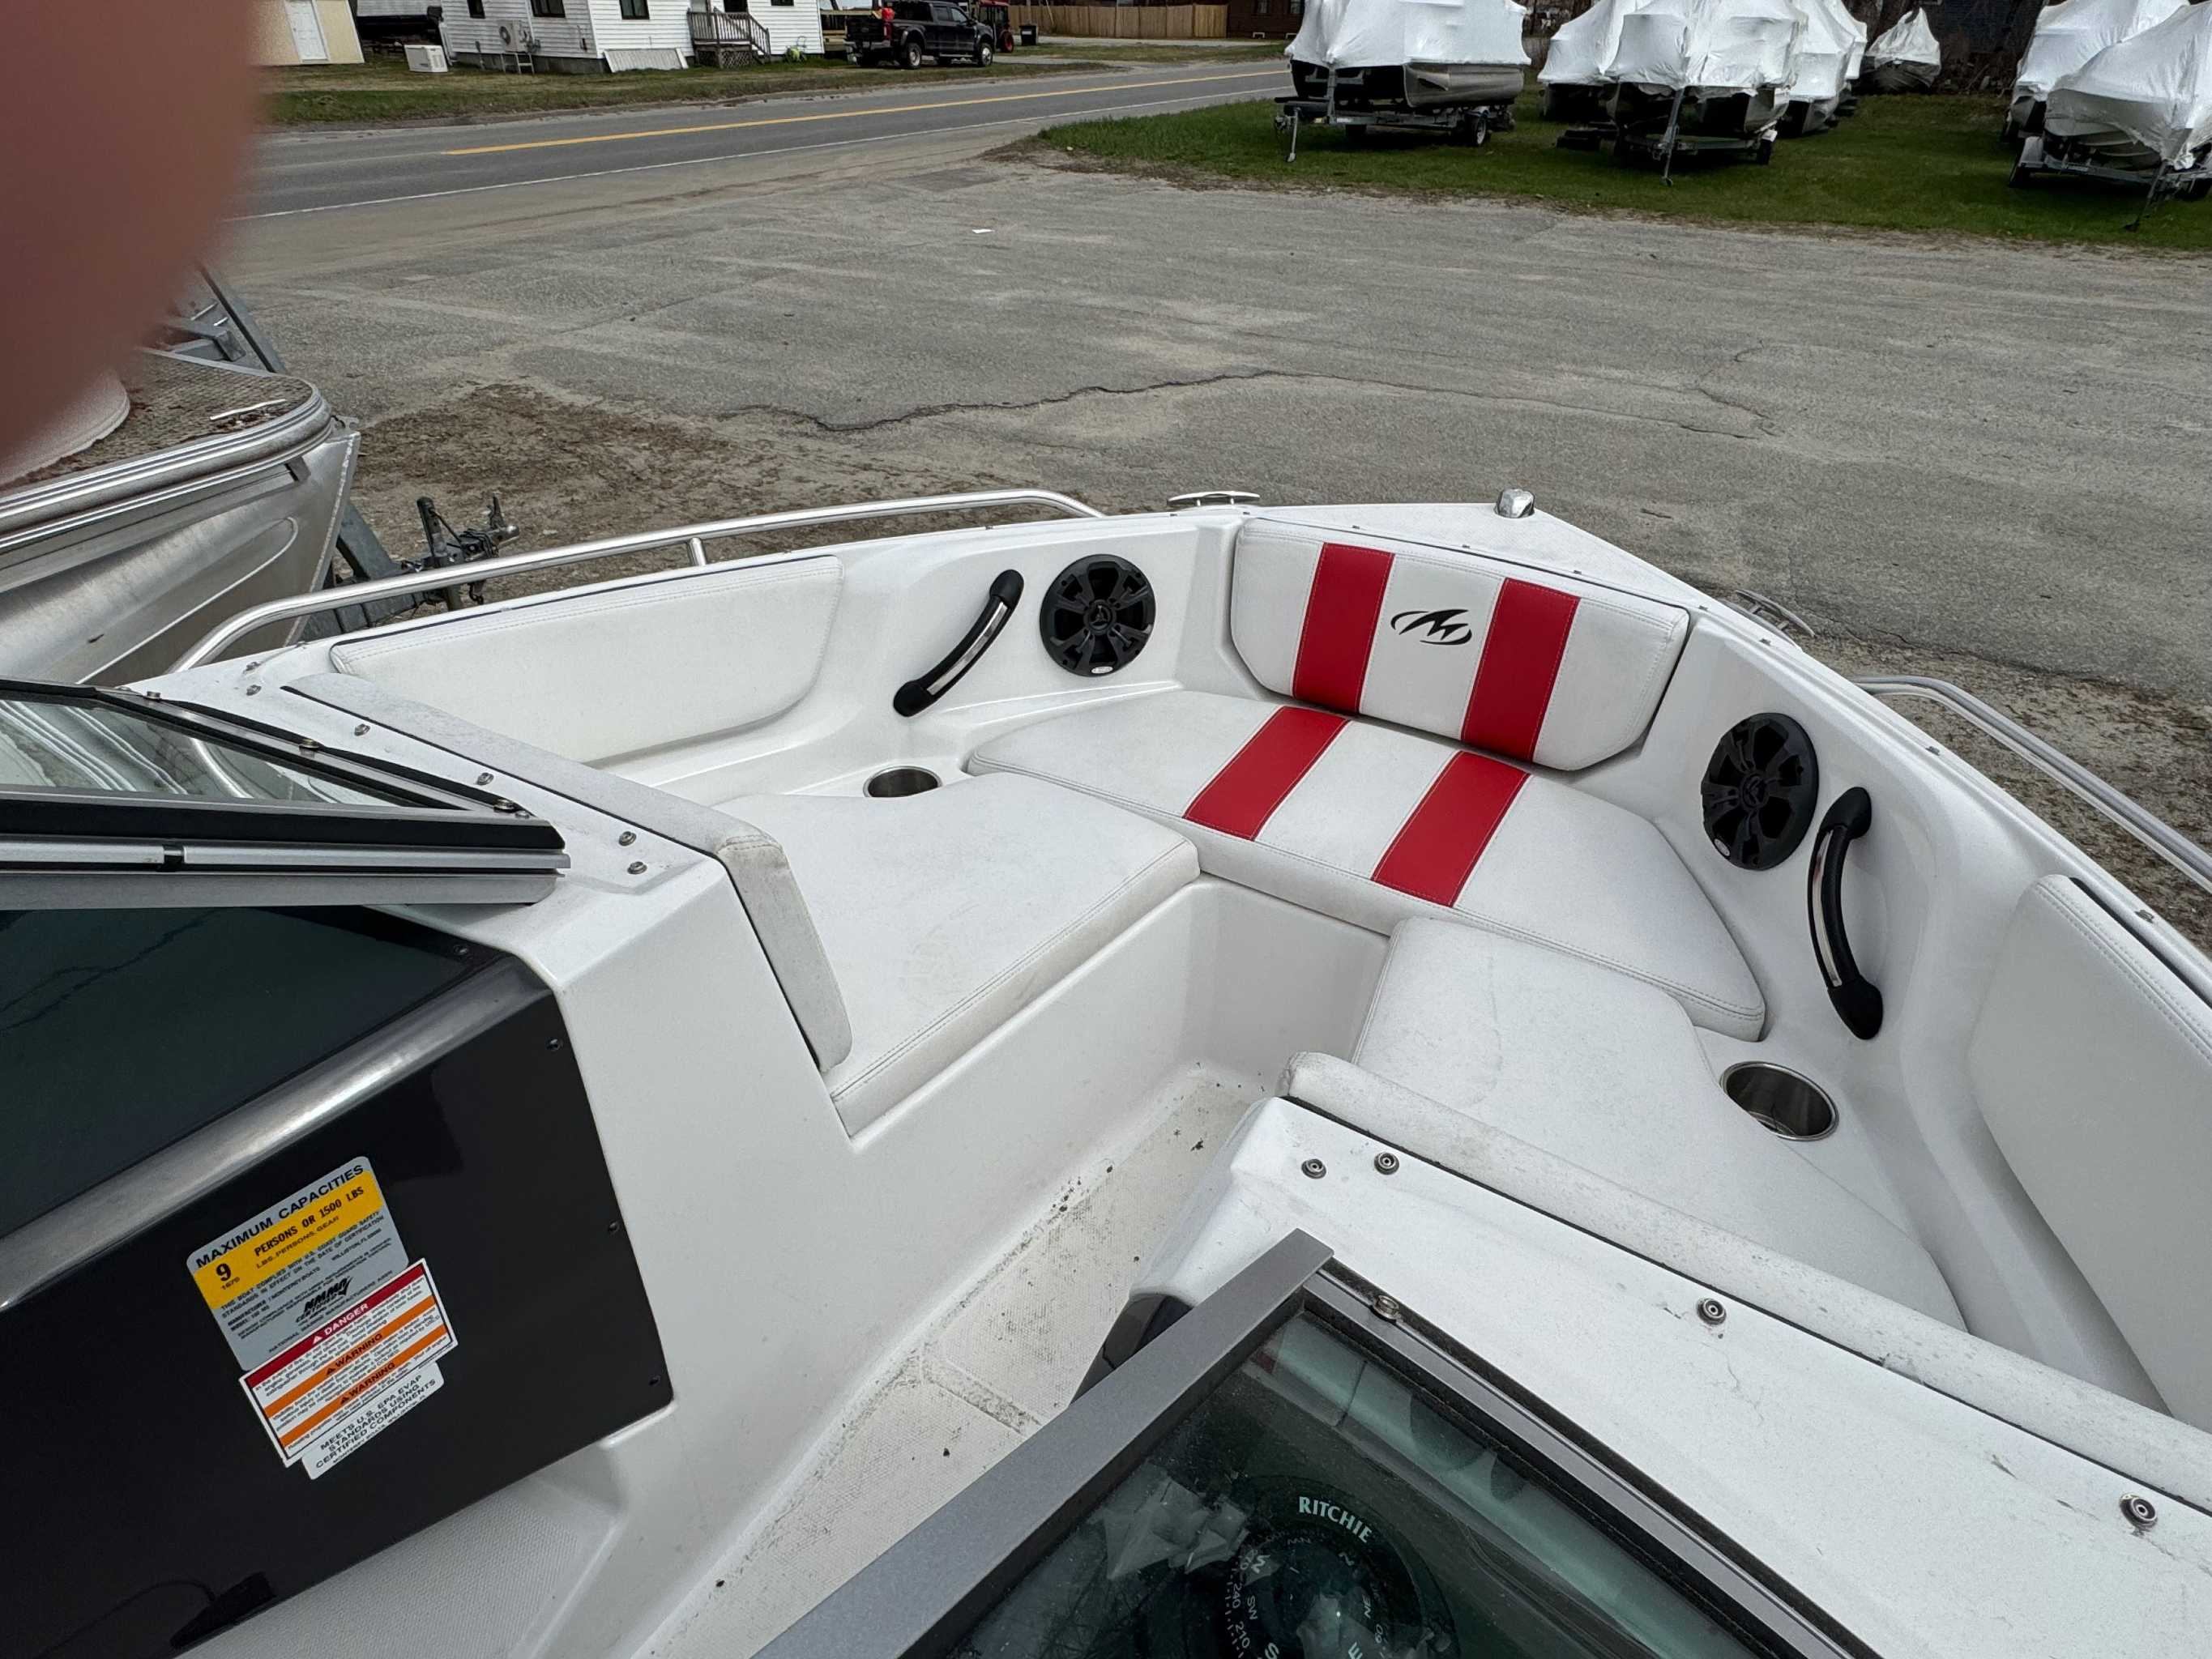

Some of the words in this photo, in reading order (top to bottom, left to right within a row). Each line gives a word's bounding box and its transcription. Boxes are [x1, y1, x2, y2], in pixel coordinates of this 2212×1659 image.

[194, 1217, 273, 1268] MAXIMUM
[277, 1163, 365, 1220] CAPACITIES
[216, 1263, 232, 1282] 9
[253, 1224, 298, 1256] PERSONS
[301, 1213, 316, 1228] OR
[318, 1198, 342, 1218] 1500
[345, 1185, 364, 1201] LBS
[316, 1215, 339, 1232] GEAR
[221, 1292, 258, 1318] STANDARDS
[268, 1271, 291, 1289] EFFECT
[304, 1256, 316, 1266] THE
[317, 1247, 332, 1258] DATE
[344, 1214, 384, 1243] CERTIFICATION
[322, 1303, 369, 1336] DANGER
[335, 1332, 382, 1367] WARNING
[348, 1361, 395, 1397] WARNING
[314, 1427, 368, 1469] CERTIFIED
[368, 1379, 436, 1429] COMPONENTS
[319, 1422, 356, 1450] MEETS
[377, 1393, 396, 1410] EPA
[397, 1374, 423, 1394] EVAP
[327, 1405, 388, 1452] STANDARDS
[391, 1384, 420, 1406] USING
[1299, 1496, 1373, 1543] RITCHIE
[1232, 1584, 1243, 1610] 240
[1246, 1595, 1258, 1620] SW
[1235, 1621, 1251, 1649] 210
